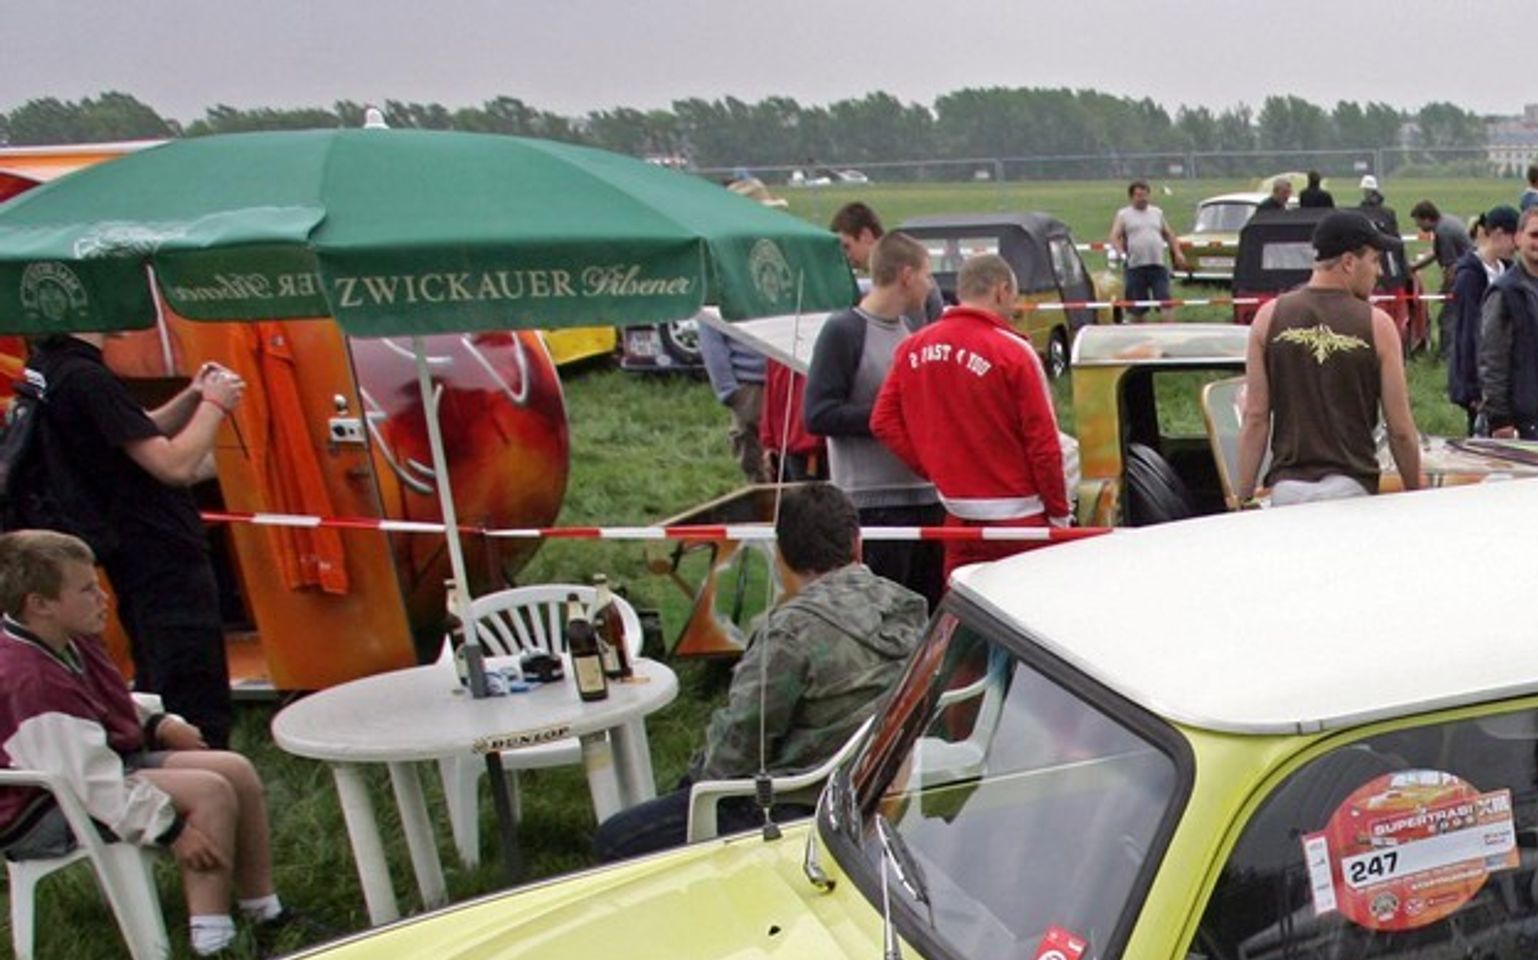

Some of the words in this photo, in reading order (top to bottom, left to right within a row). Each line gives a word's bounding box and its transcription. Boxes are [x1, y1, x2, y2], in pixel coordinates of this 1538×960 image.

[334, 269, 577, 308] ZWICKAUER
[580, 264, 694, 298] Pilsener
[491, 726, 570, 749] DUNLOP
[1373, 804, 1474, 836] SUPERTRABI
[1350, 852, 1399, 883] 247
